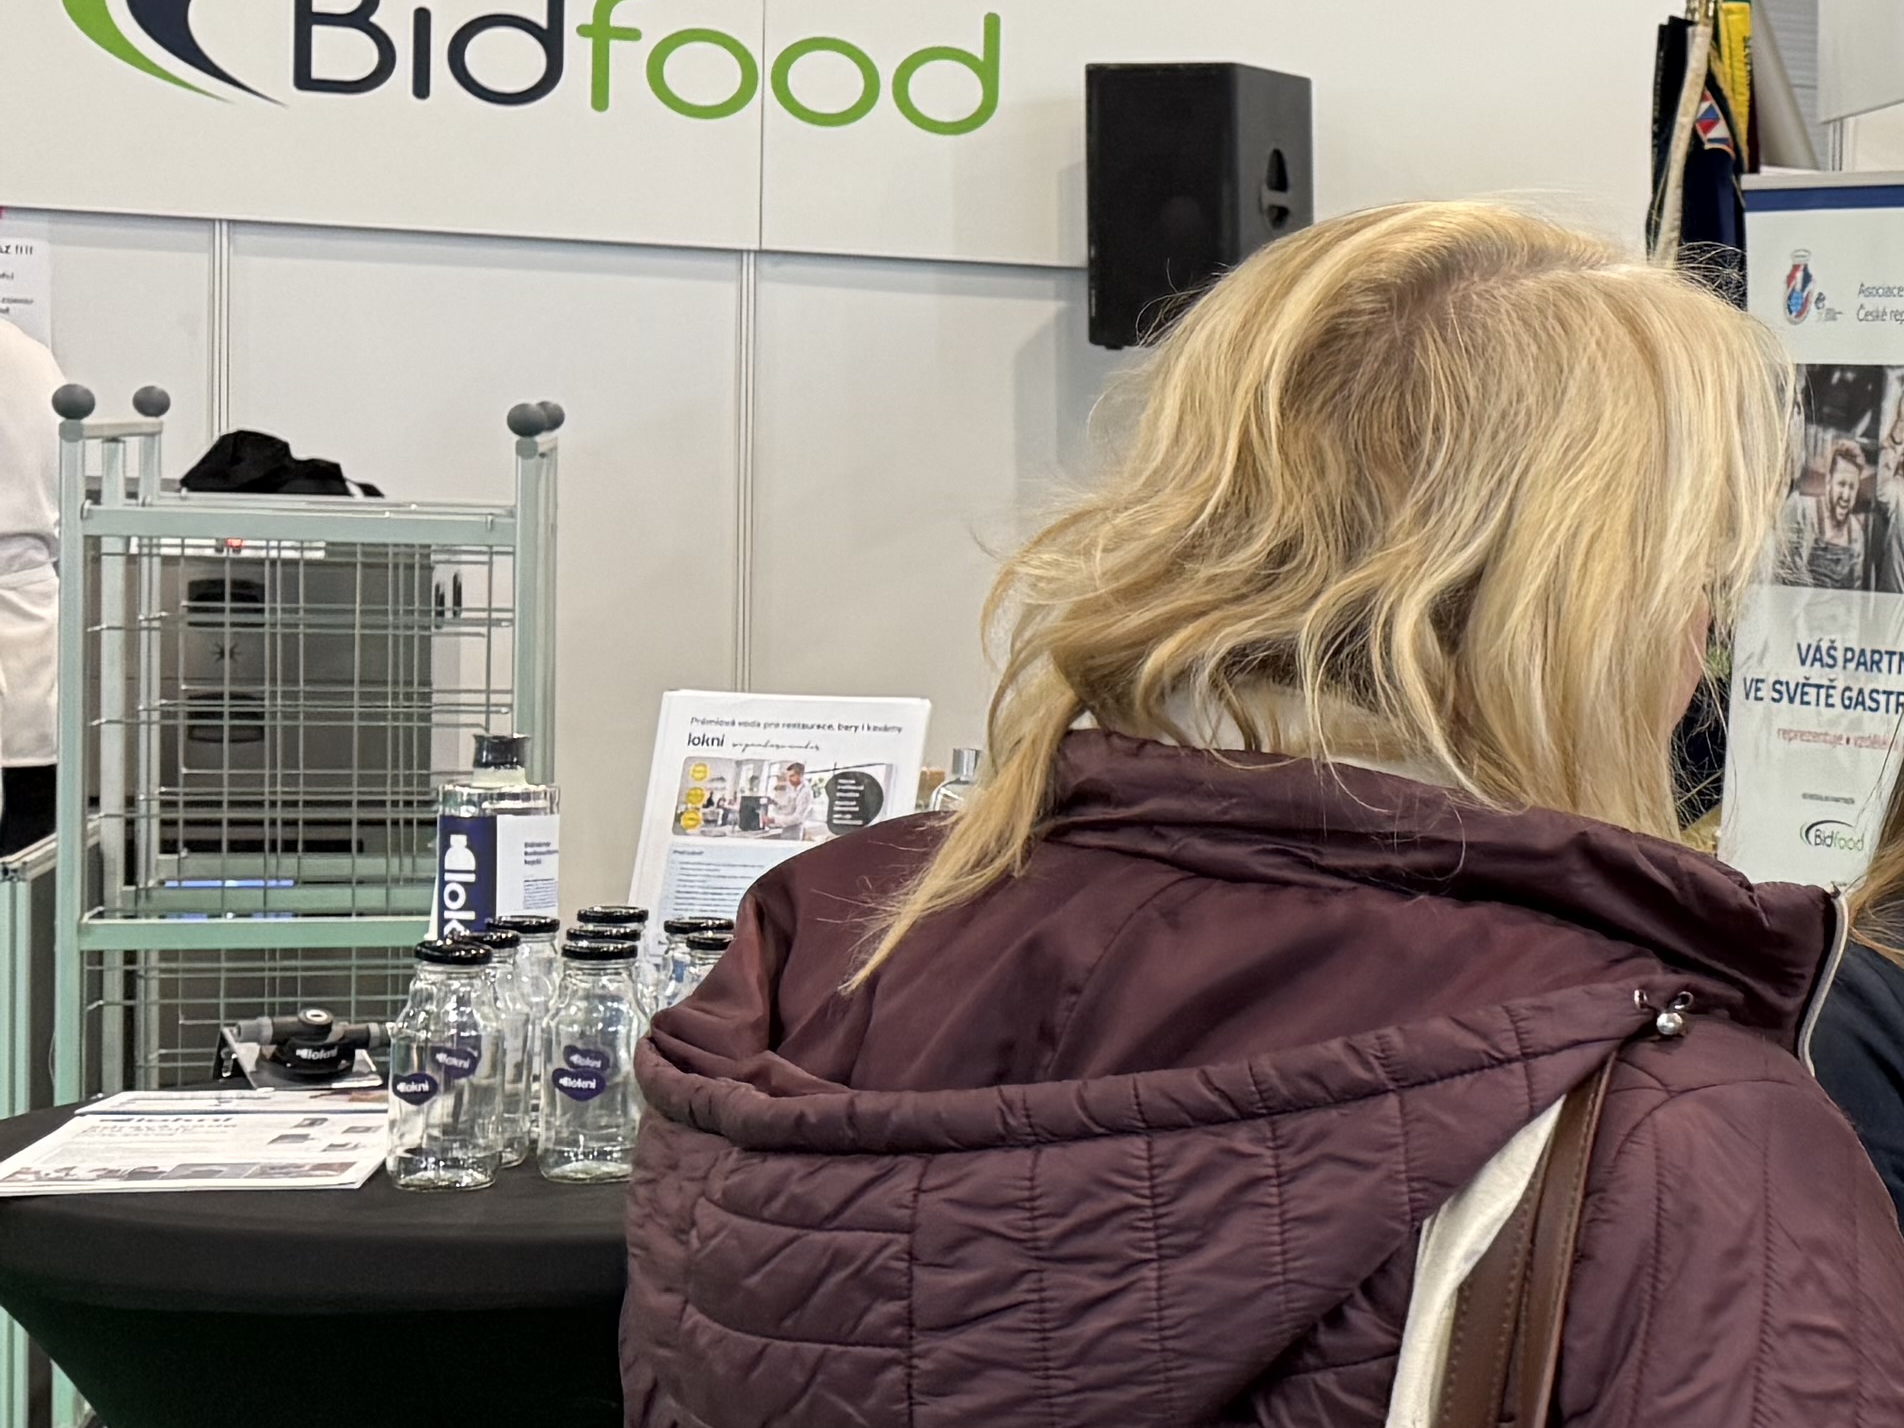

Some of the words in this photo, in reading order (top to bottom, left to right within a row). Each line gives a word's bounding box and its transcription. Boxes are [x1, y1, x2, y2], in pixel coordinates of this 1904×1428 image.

[1858, 282, 1904, 298] Asociace
[1797, 637, 1838, 669] VÁŠ
[1743, 677, 1765, 701] VE
[1771, 676, 1837, 709] SVĚTĚ
[687, 732, 725, 749] lokni
[1814, 828, 1864, 852] Bidfood
